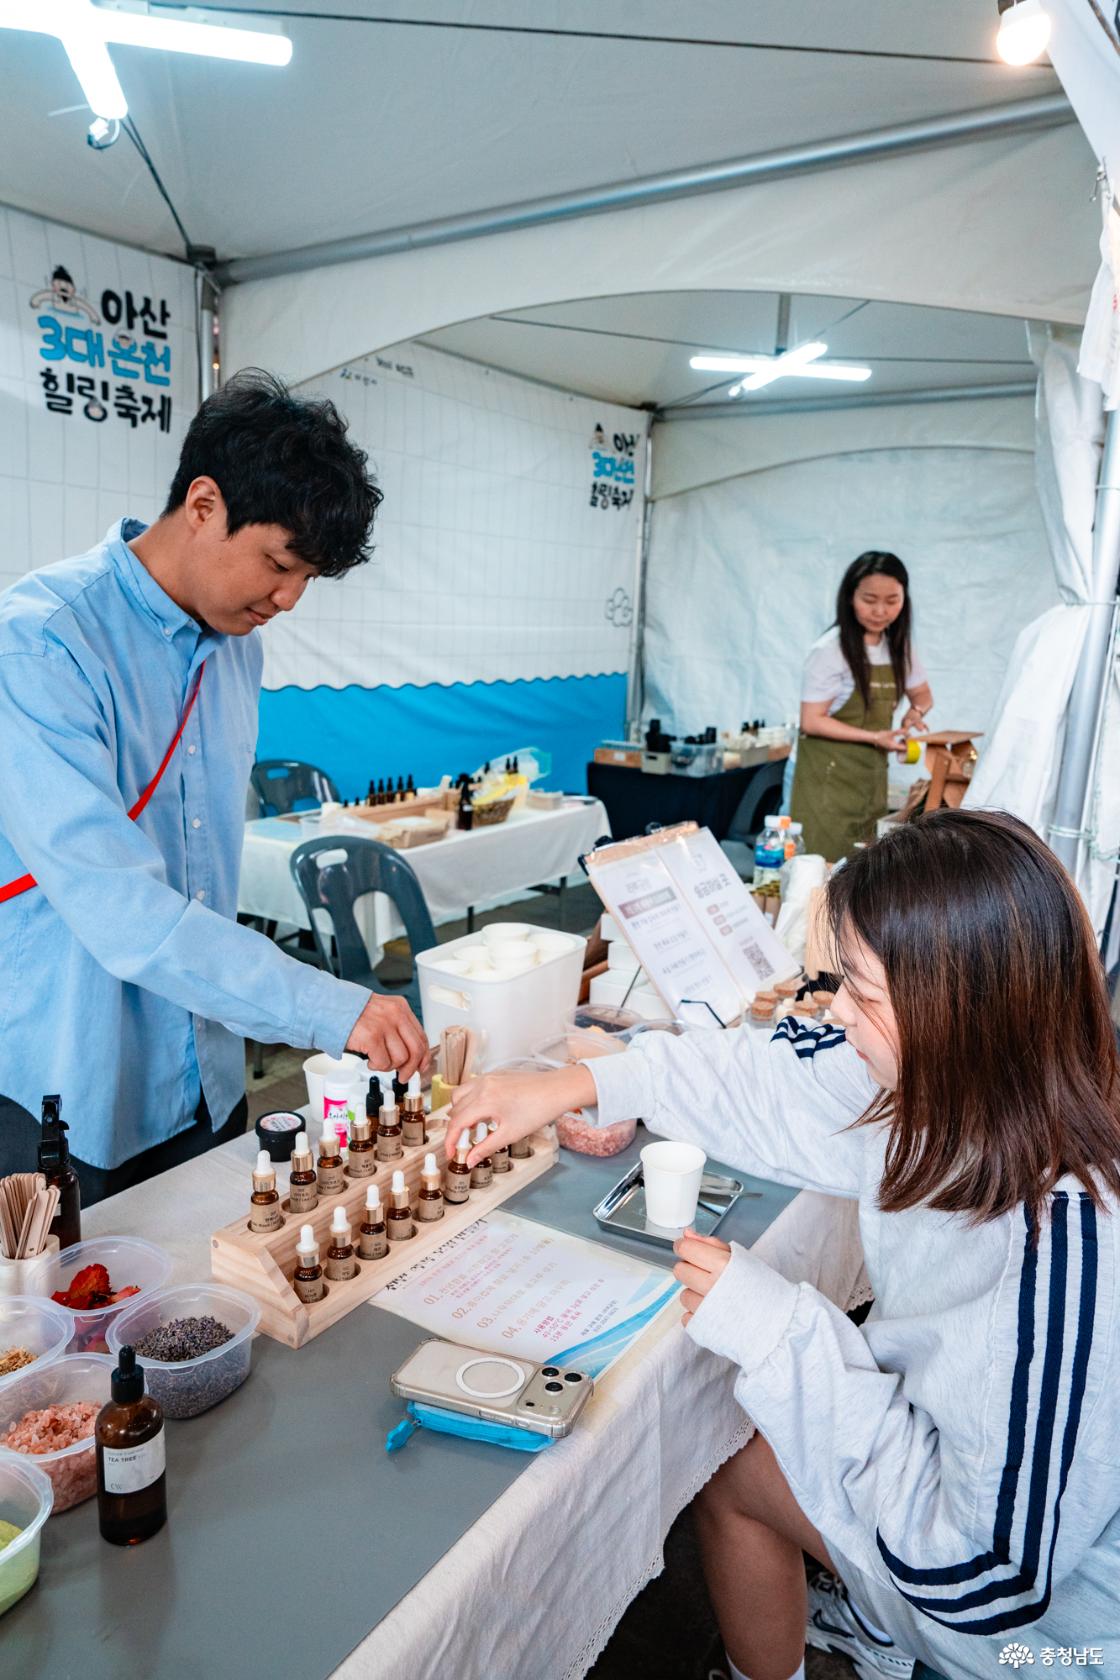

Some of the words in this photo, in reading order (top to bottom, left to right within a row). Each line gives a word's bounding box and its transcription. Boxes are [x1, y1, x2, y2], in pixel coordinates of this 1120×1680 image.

[101, 289, 171, 339] 아산
[477, 1317, 497, 1328] 03.
[502, 1326, 522, 1338] 04.
